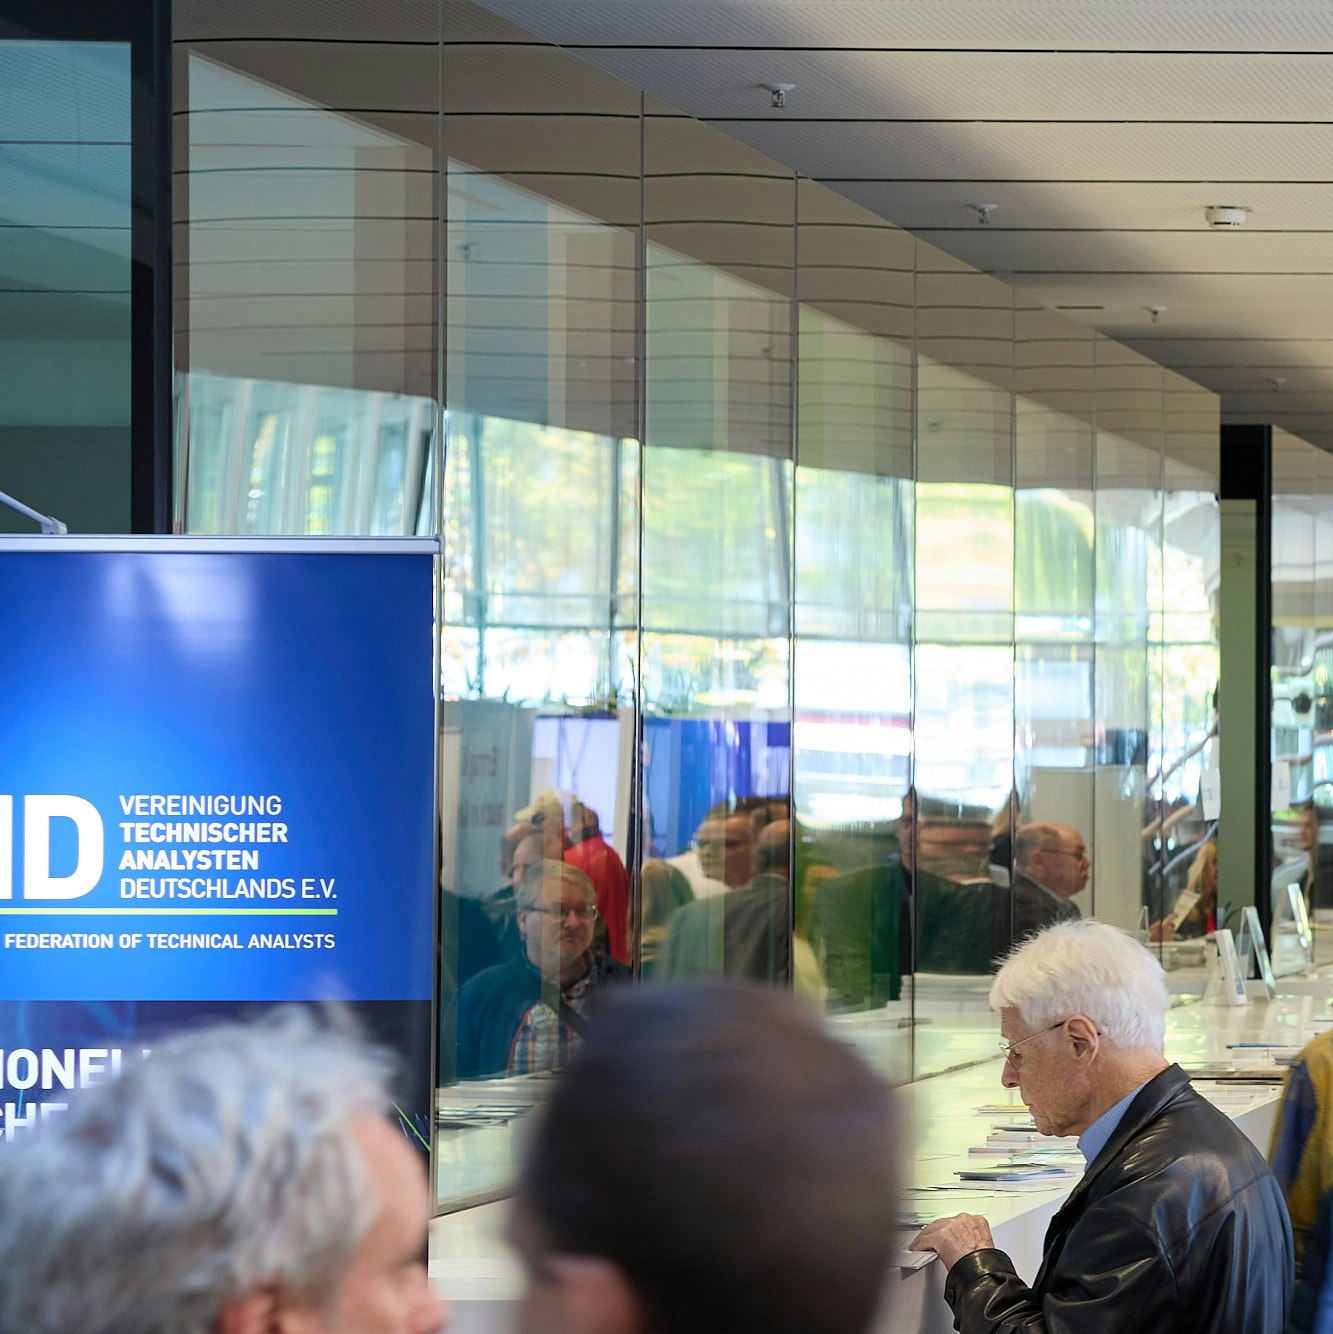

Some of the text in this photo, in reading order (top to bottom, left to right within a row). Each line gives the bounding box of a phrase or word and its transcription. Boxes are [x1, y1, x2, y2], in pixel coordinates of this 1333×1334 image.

[119, 795, 282, 816] VEREINIGUNG
[119, 823, 288, 843] TECHNISCHER
[0, 795, 104, 899] D
[119, 850, 258, 870] ANALYSTEN
[120, 878, 337, 899] DEUTSCHLANDS E.V.
[5, 934, 335, 949] FEDERATION OF TECHNICAL ANALYSTS
